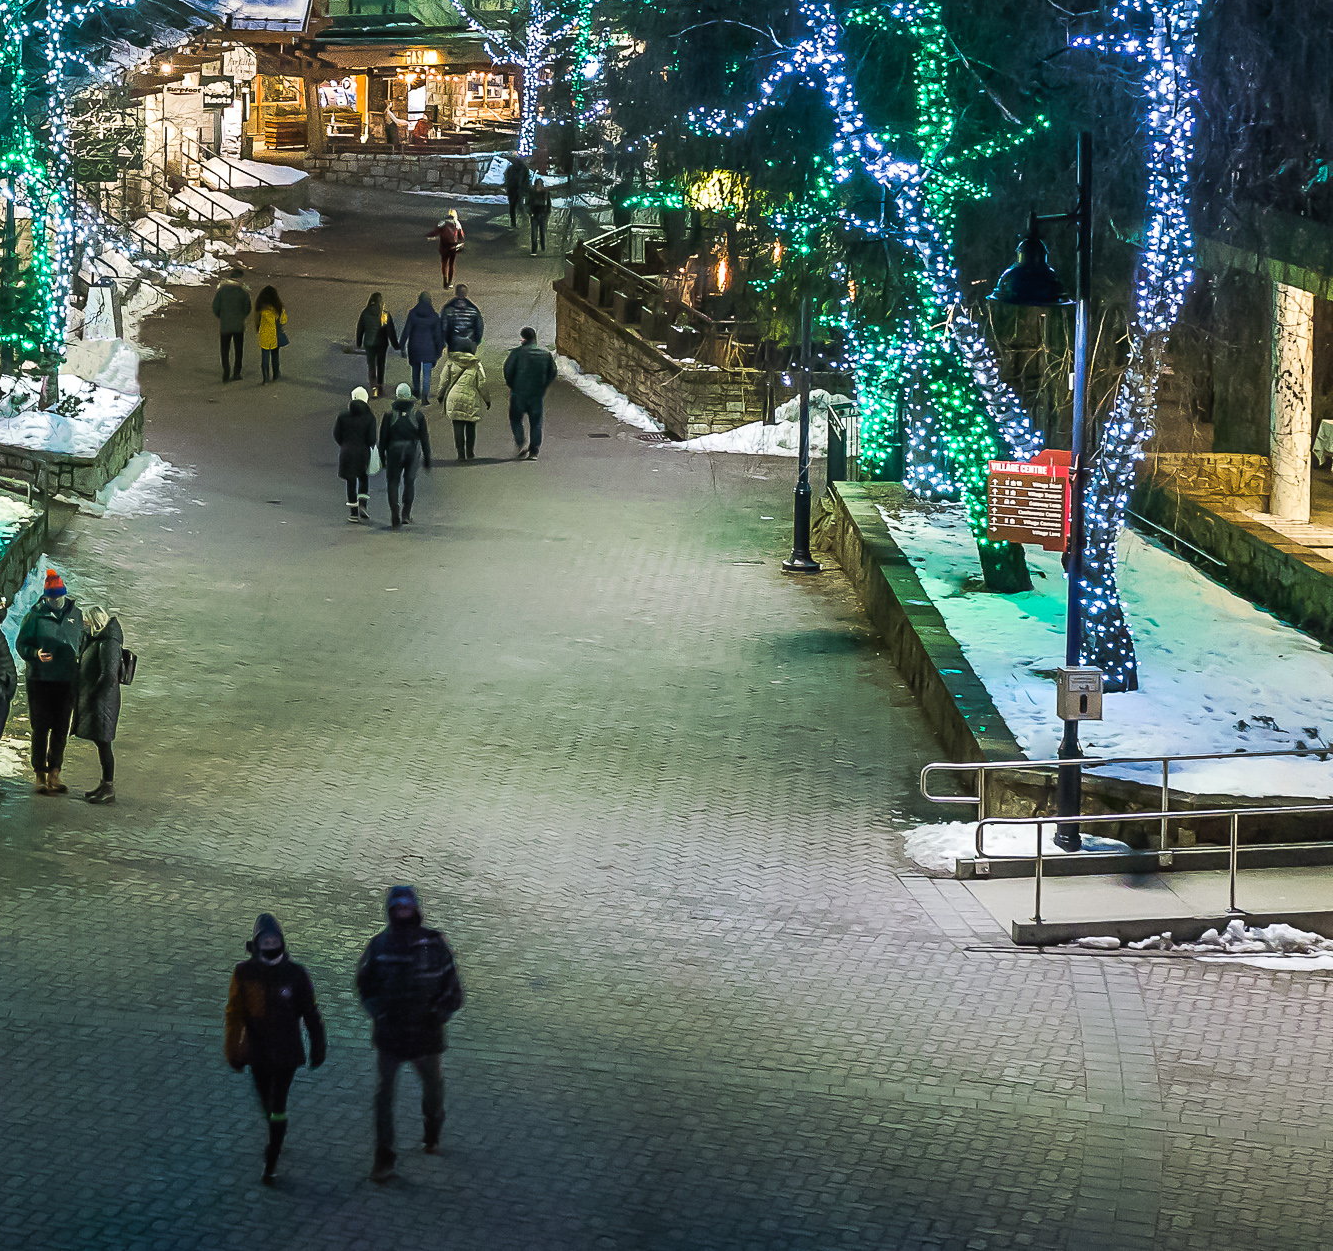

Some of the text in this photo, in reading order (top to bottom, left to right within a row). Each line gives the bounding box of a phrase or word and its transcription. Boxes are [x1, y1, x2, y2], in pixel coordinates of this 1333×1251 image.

[204, 95, 232, 104] Roots
[991, 462, 1048, 475] VILLAGE CENTRE
